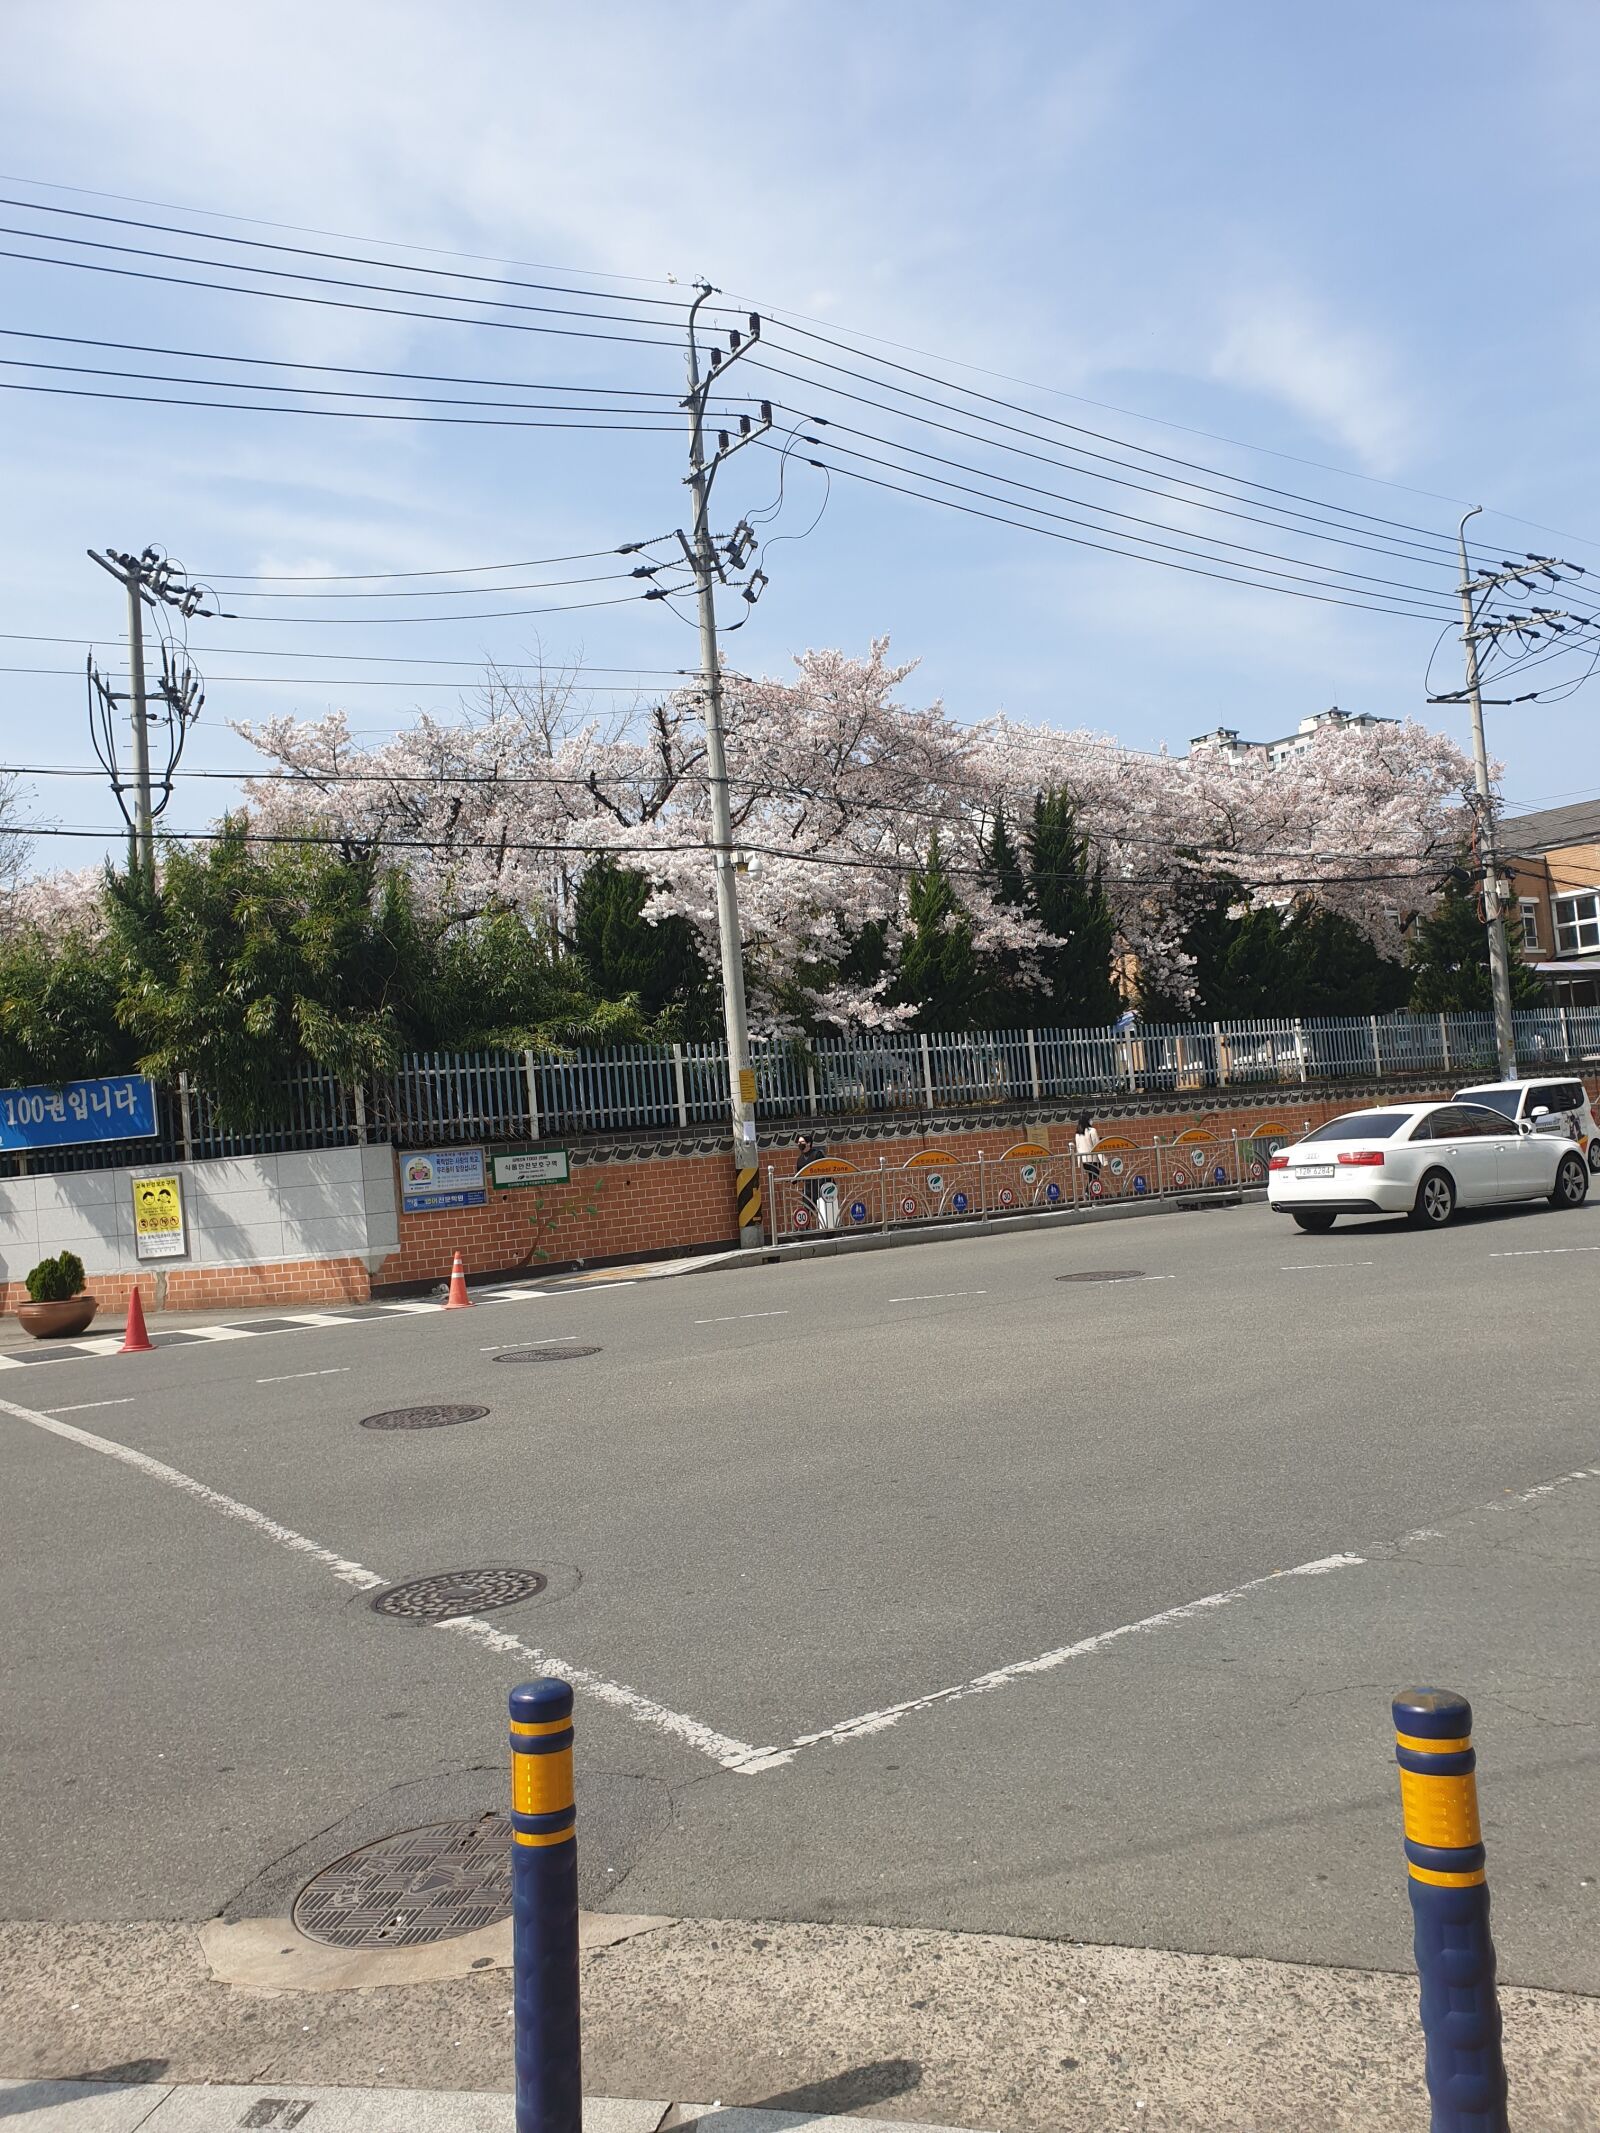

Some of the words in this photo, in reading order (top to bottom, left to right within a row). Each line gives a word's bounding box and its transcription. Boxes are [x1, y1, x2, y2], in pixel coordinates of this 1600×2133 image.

[6, 1084, 138, 1126] 100권입니다
[1003, 1192, 1011, 1201] 30
[905, 1202, 914, 1211] 30
[797, 1213, 806, 1223] 30
